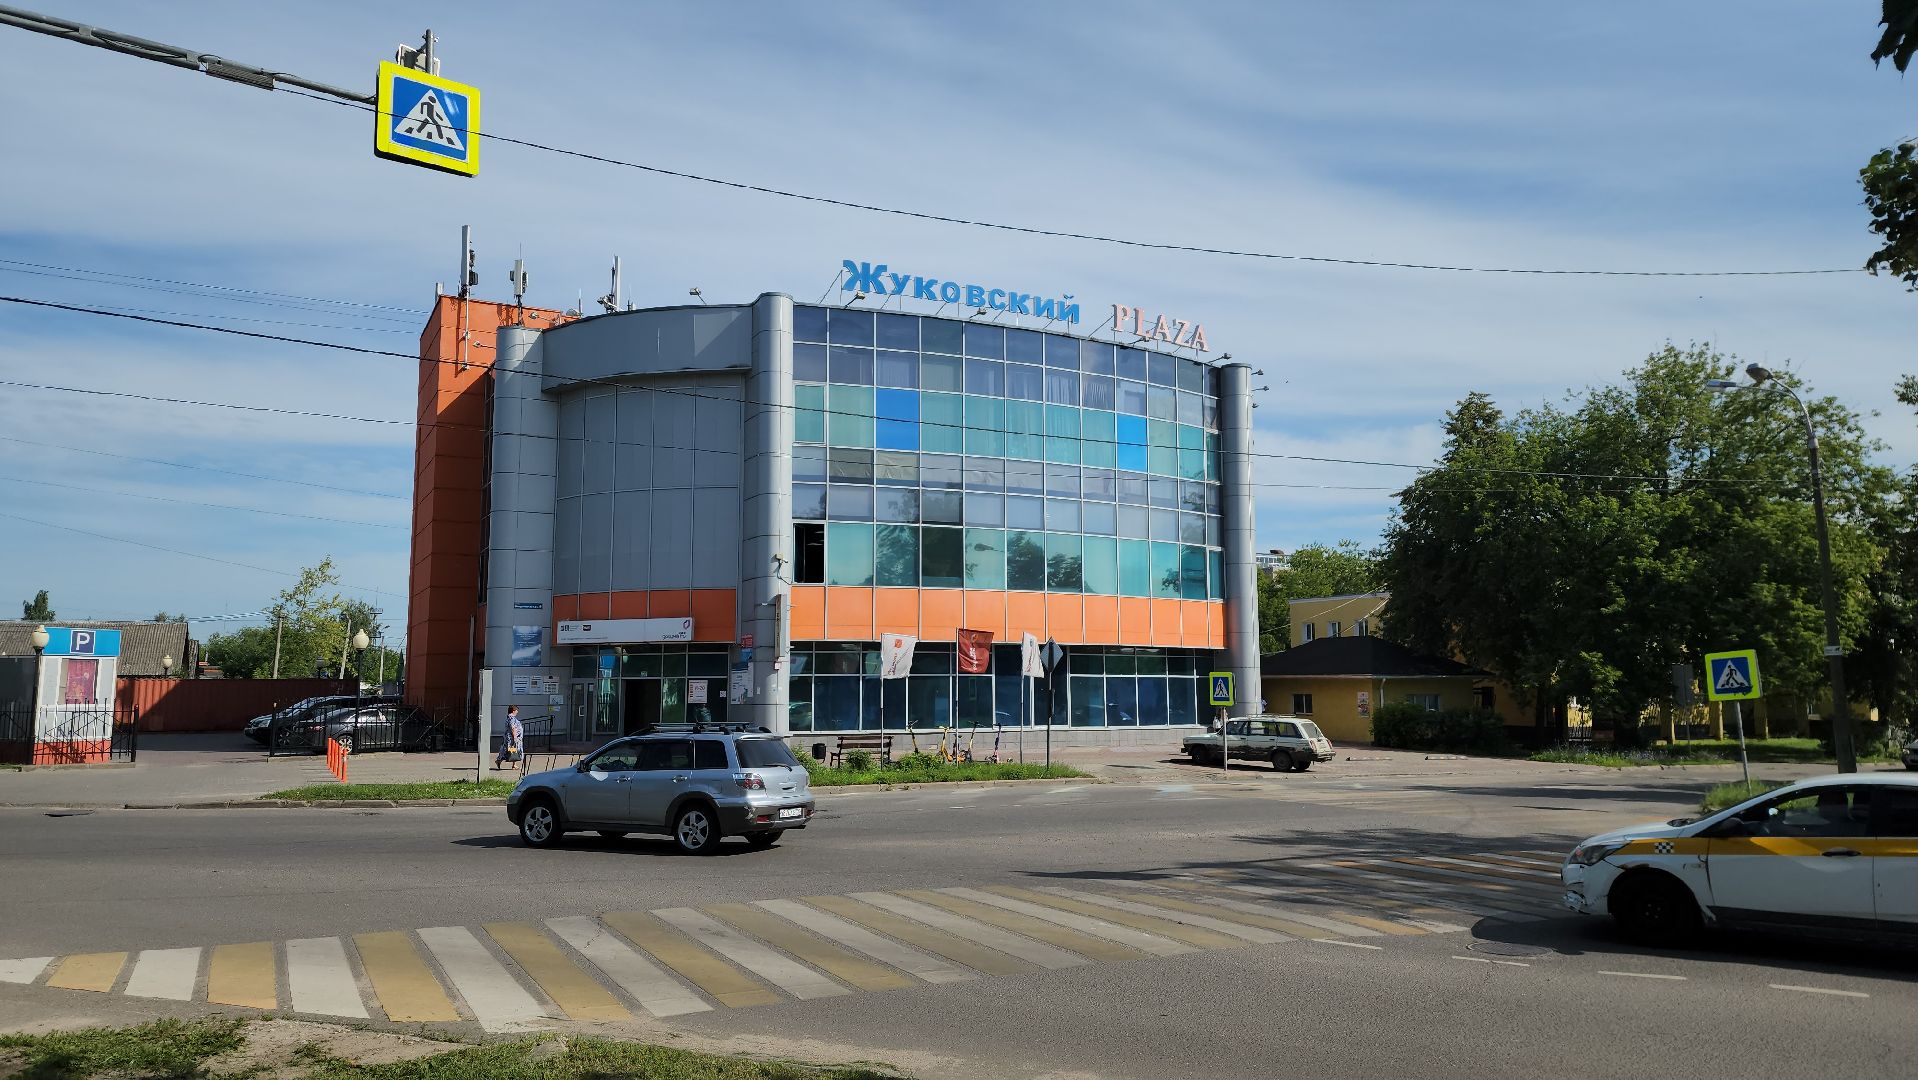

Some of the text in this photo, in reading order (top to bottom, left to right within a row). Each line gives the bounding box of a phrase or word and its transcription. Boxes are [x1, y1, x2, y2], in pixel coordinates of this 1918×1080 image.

[842, 259, 1210, 352] Жуковский PLAZA
[76, 632, 91, 651] P
